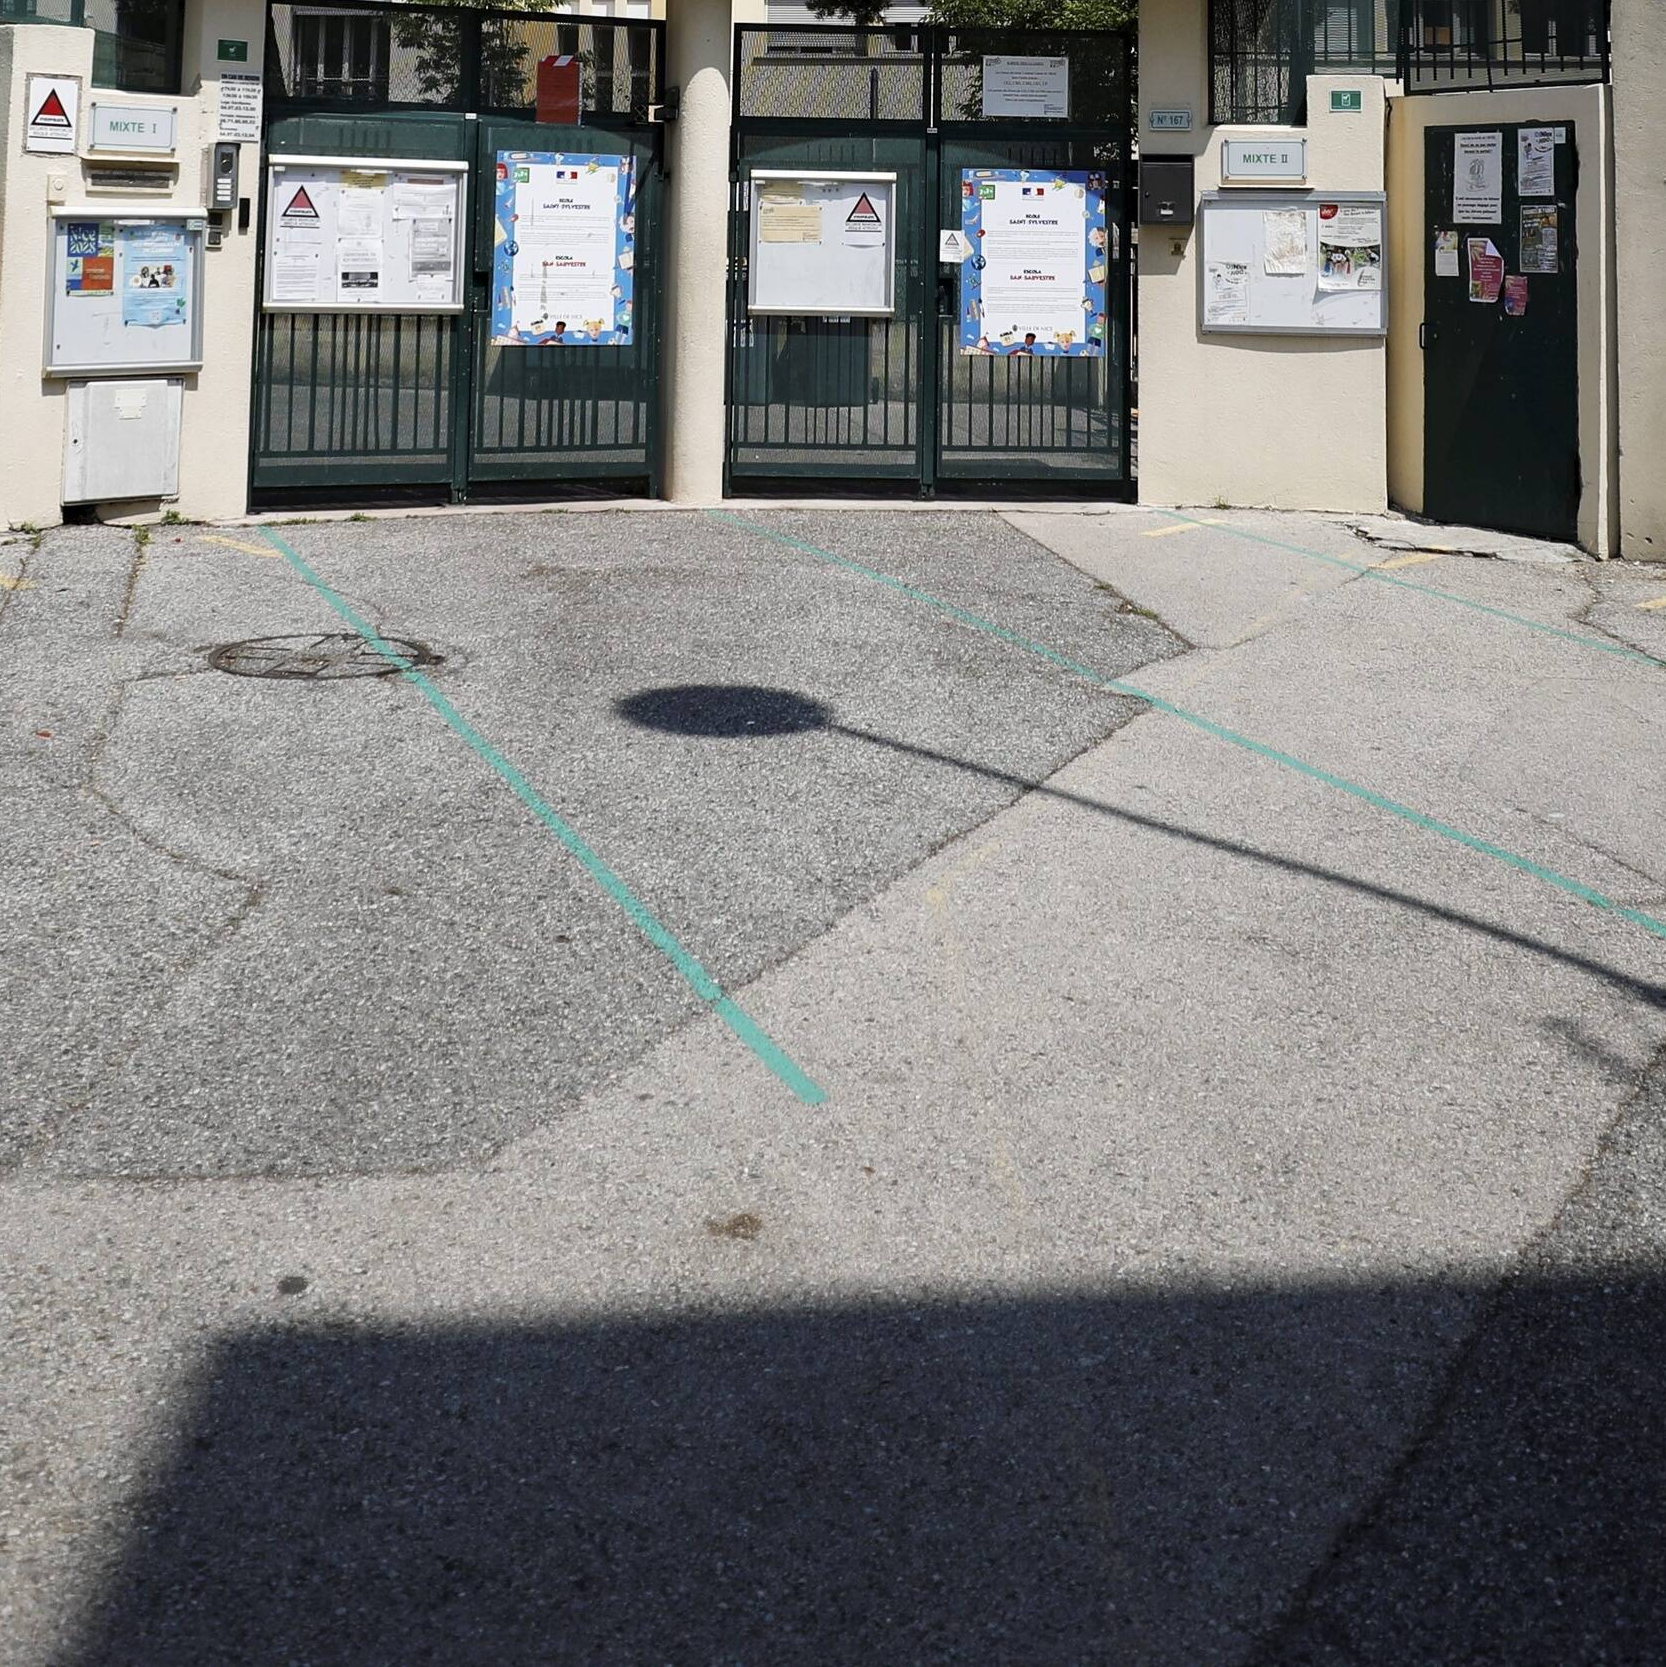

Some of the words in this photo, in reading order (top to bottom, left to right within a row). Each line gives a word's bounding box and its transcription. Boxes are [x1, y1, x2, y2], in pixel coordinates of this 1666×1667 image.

[1170, 115, 1183, 125] 167
[109, 121, 144, 133] MIXTE
[152, 123, 157, 133] I
[1242, 154, 1276, 163] MIXTE
